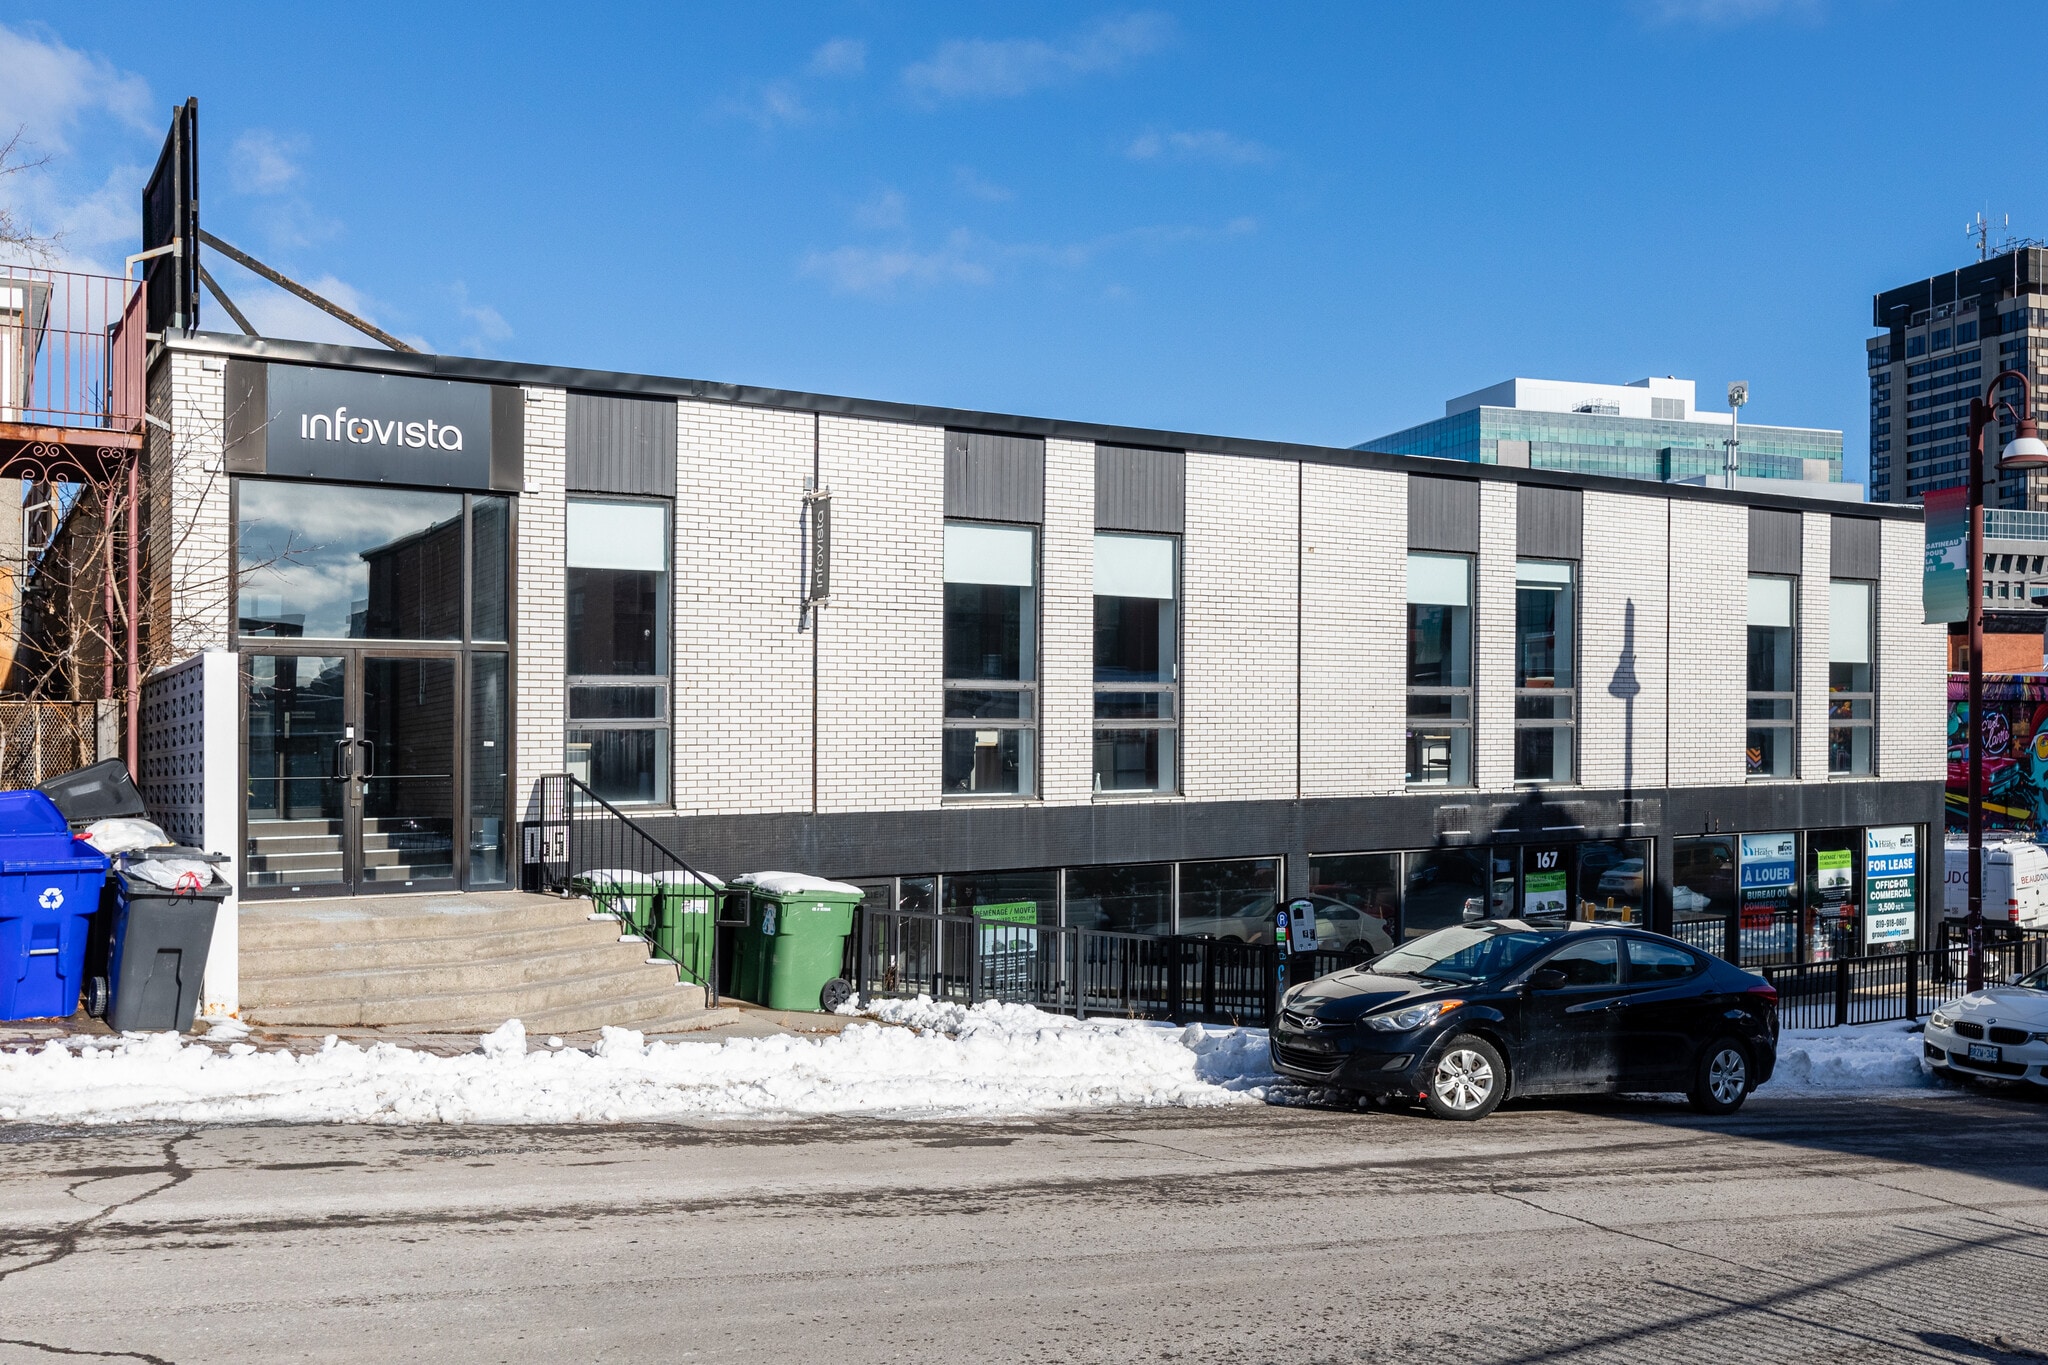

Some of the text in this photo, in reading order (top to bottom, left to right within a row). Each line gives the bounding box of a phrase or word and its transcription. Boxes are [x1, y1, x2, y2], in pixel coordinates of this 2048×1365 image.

[301, 407, 463, 450] infovista
[815, 510, 824, 588] infovista
[1925, 539, 1959, 550] GATINEAU
[1925, 549, 1944, 557] POUR
[1536, 851, 1558, 868] 167
[1868, 857, 1913, 872] FOR LEASE
[1744, 866, 1790, 883] À LOUER
[1875, 878, 1908, 890] OFFICE OR
[1747, 888, 1788, 900] BUREAU OU
[1870, 888, 1912, 900] COMMERCIAL
[1014, 906, 1036, 915] MOVED
[1744, 901, 1790, 911] COMMERCIAL
[1877, 901, 1895, 912] 3,500
